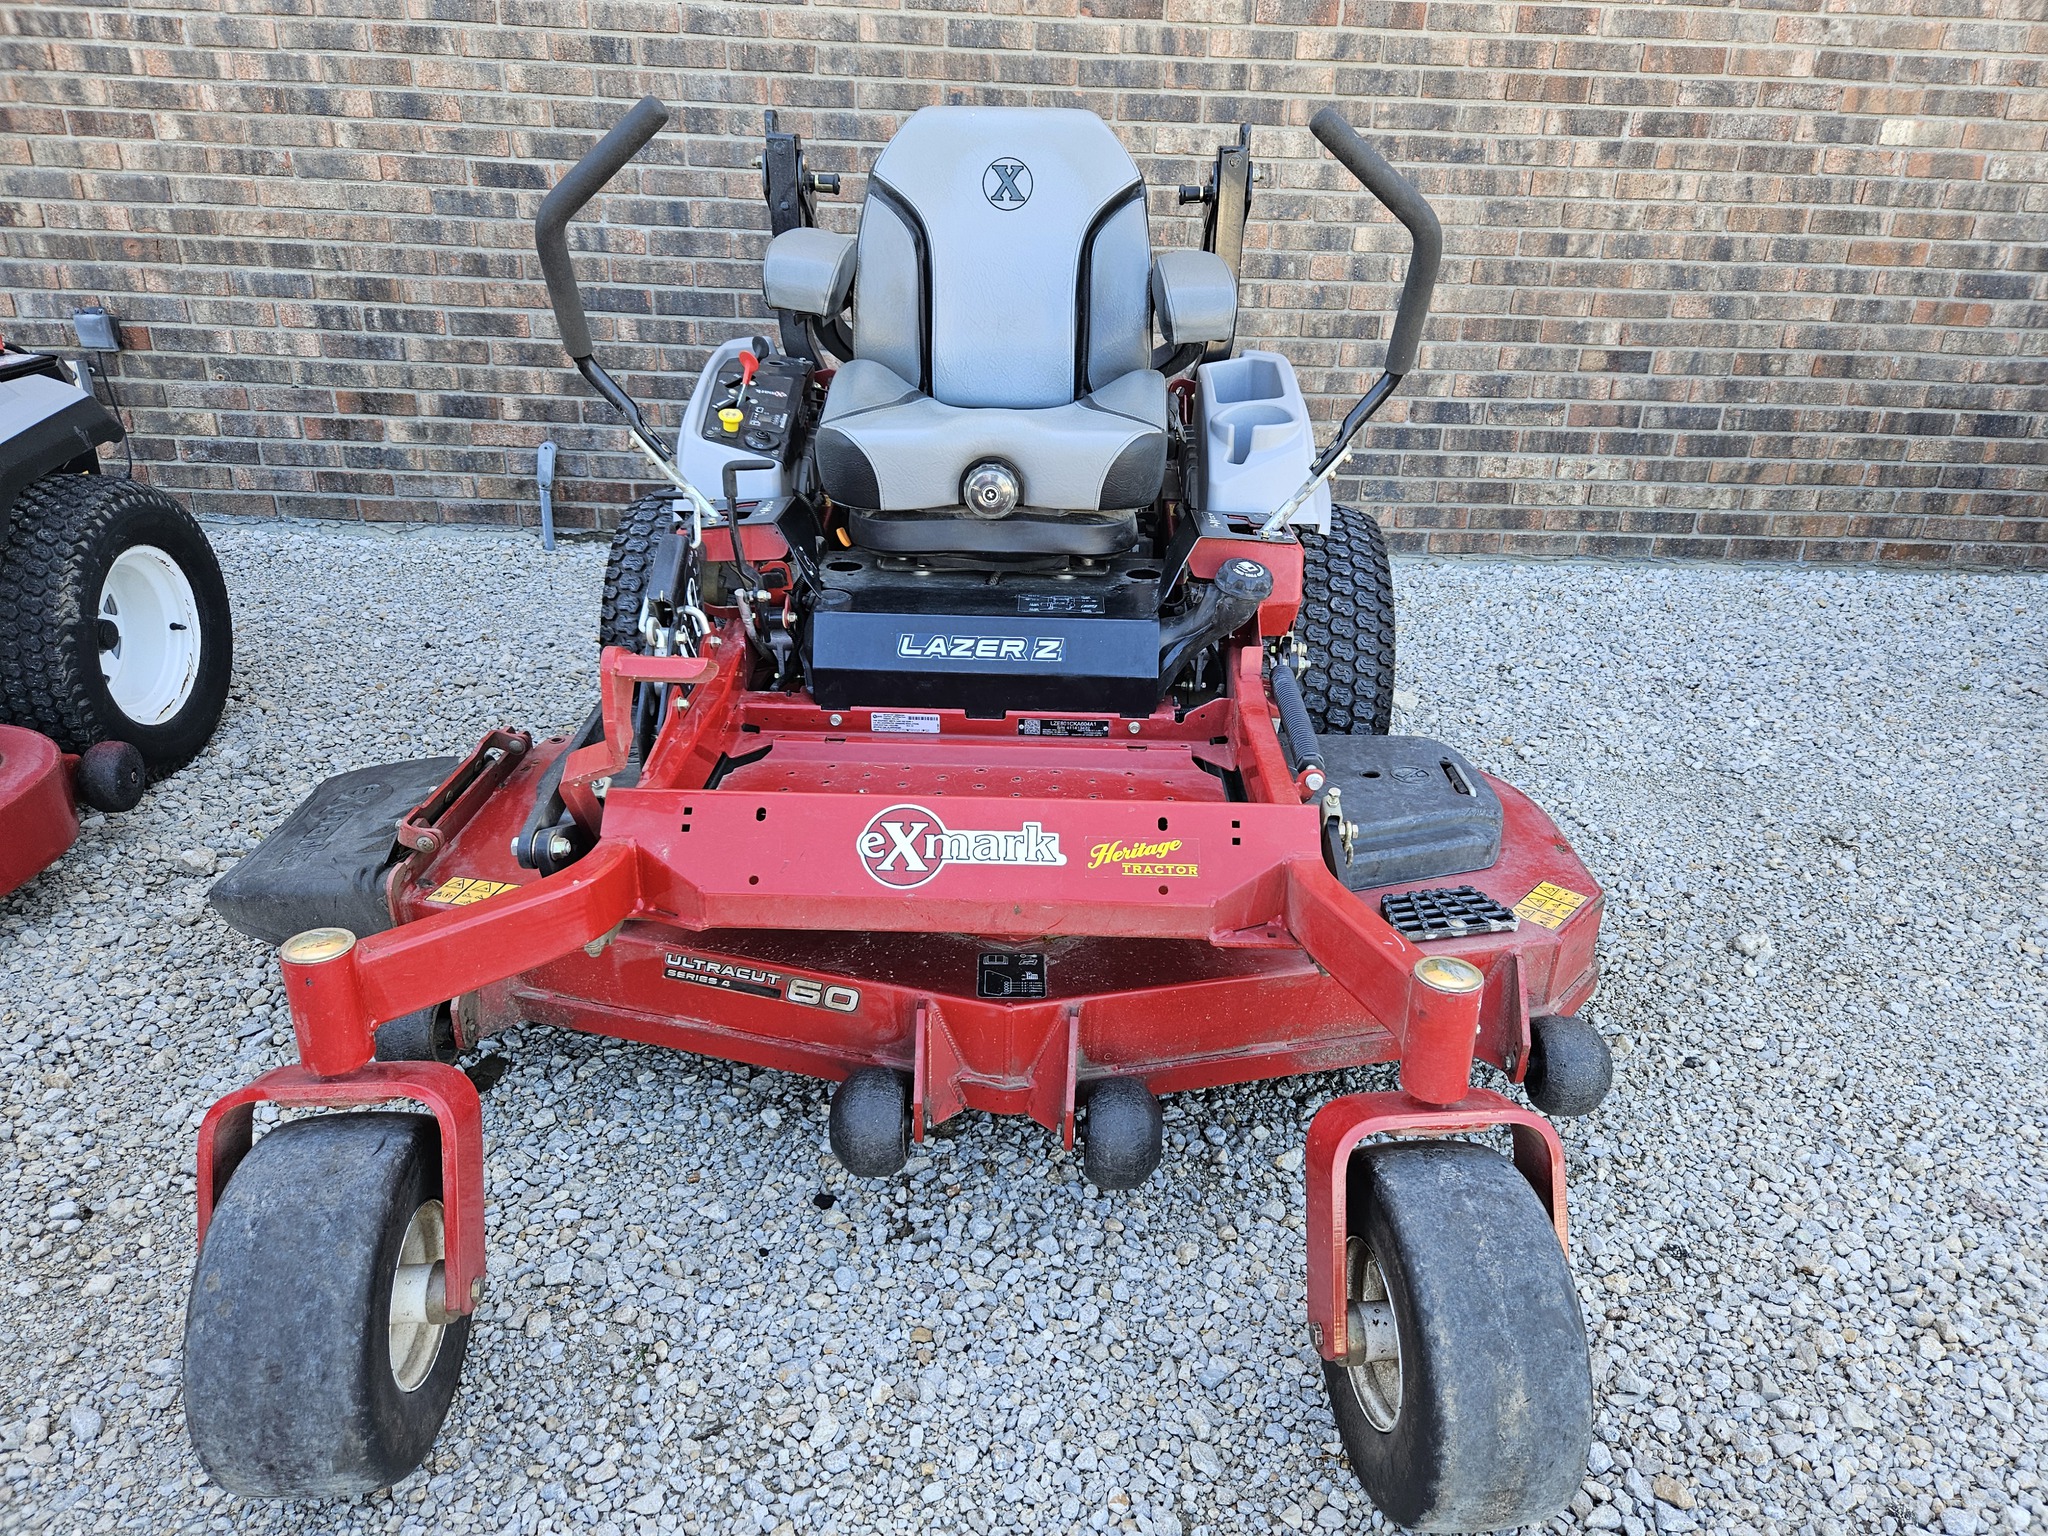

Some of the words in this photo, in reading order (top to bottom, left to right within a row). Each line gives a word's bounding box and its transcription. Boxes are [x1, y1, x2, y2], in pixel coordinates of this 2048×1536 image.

[990, 164, 1026, 202] X
[898, 634, 1028, 661] LAZER
[1030, 637, 1065, 661] Z
[1087, 838, 1183, 869] Heritage
[1122, 863, 1199, 876] TRACTOR
[665, 952, 781, 985] ULTRACUT
[667, 969, 718, 985] SERIES
[721, 979, 731, 988] 4
[786, 977, 861, 1013] 60
